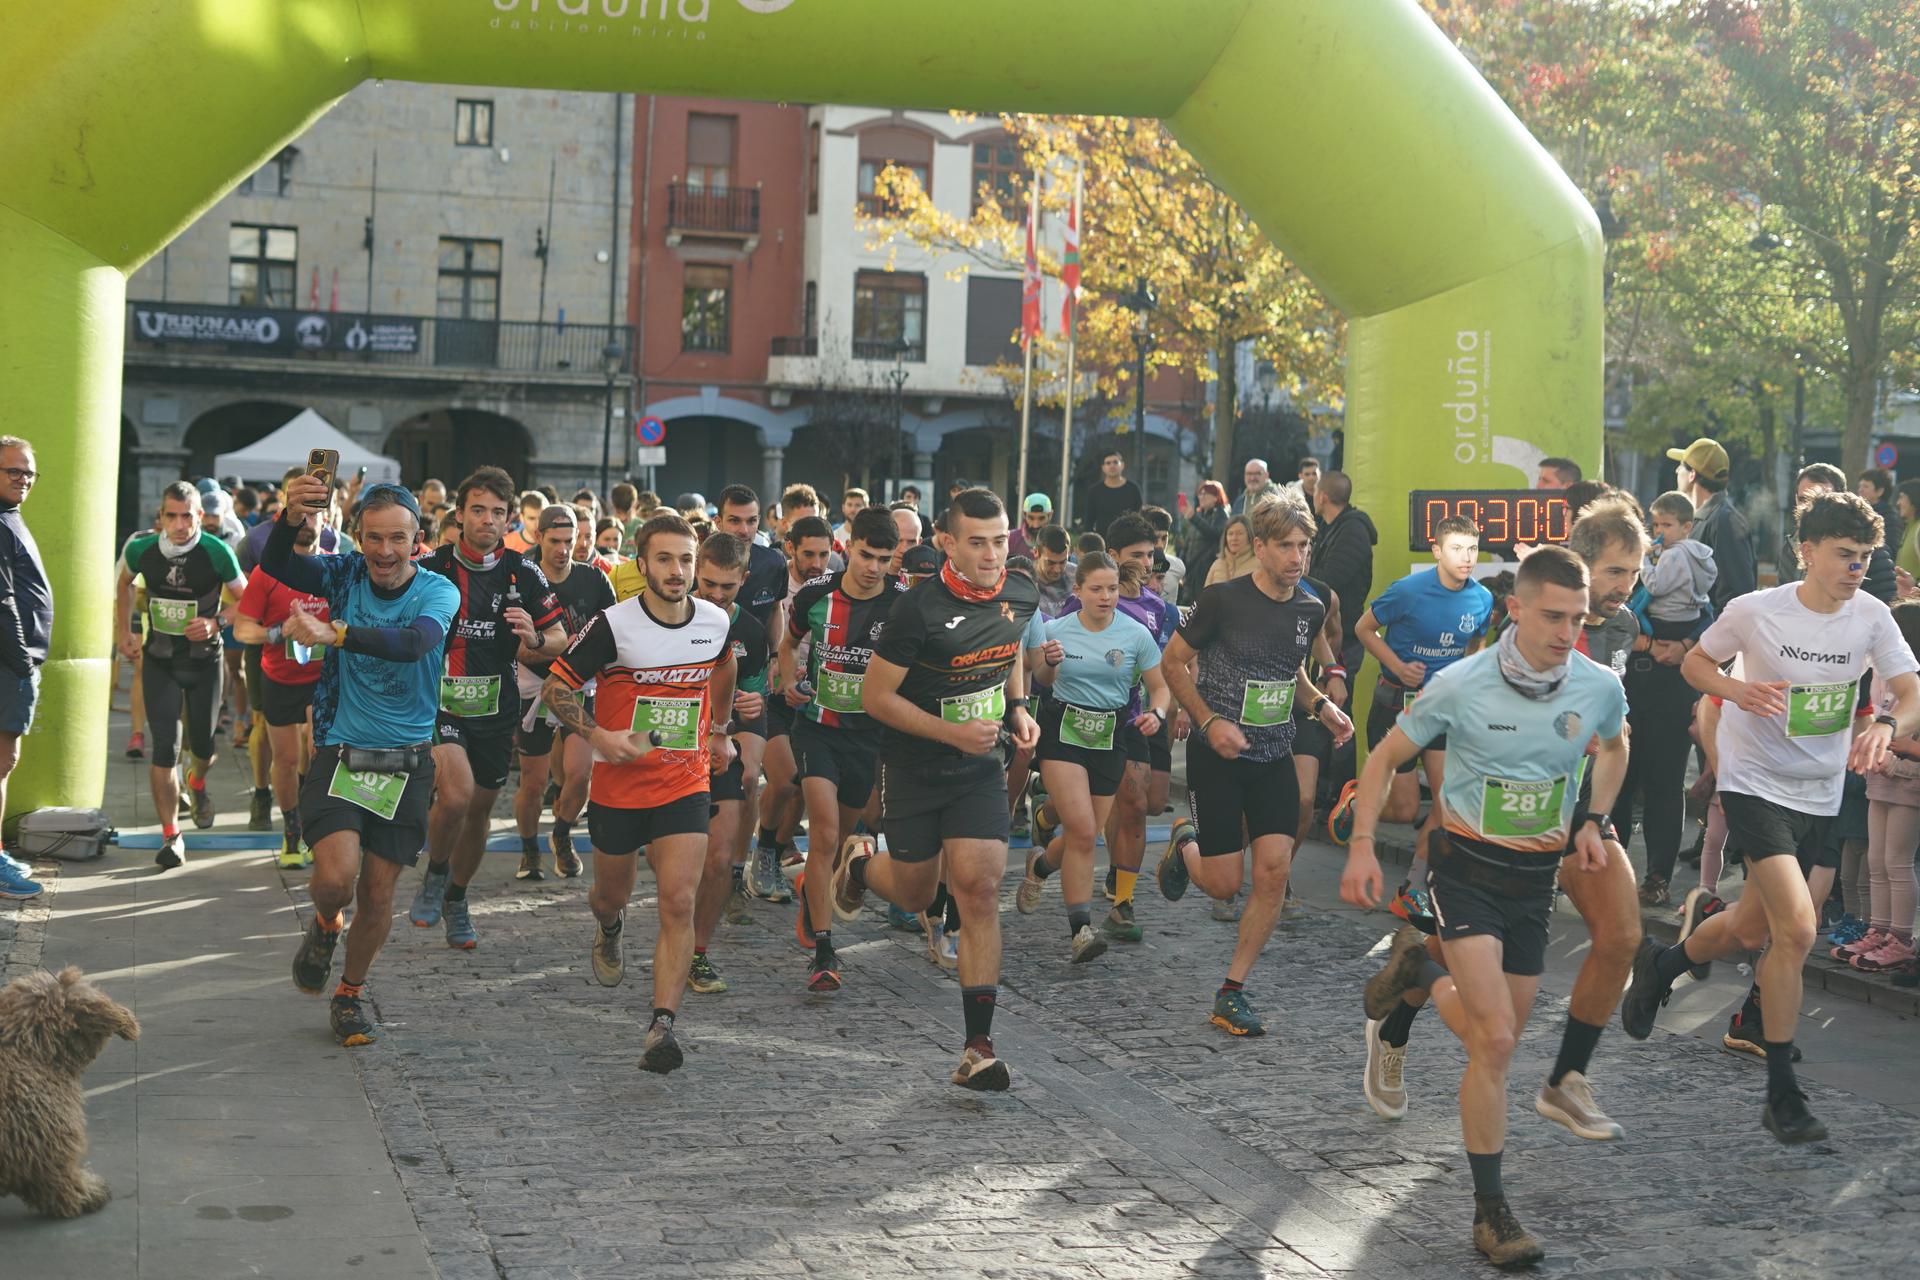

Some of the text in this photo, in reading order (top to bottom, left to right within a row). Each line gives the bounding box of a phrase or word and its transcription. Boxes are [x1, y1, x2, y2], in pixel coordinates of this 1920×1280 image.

[489, 16, 608, 33] dabilen
[1441, 330, 1478, 464] orduña
[158, 606, 187, 619] 369
[1780, 645, 1851, 664] Normal
[453, 685, 489, 699] 293
[827, 680, 860, 695] 311
[1257, 690, 1289, 706] 445
[1803, 692, 1847, 713] 412
[648, 708, 689, 727] 388
[957, 698, 993, 721] 301
[1073, 716, 1106, 732] 296
[1500, 790, 1553, 812] 287
